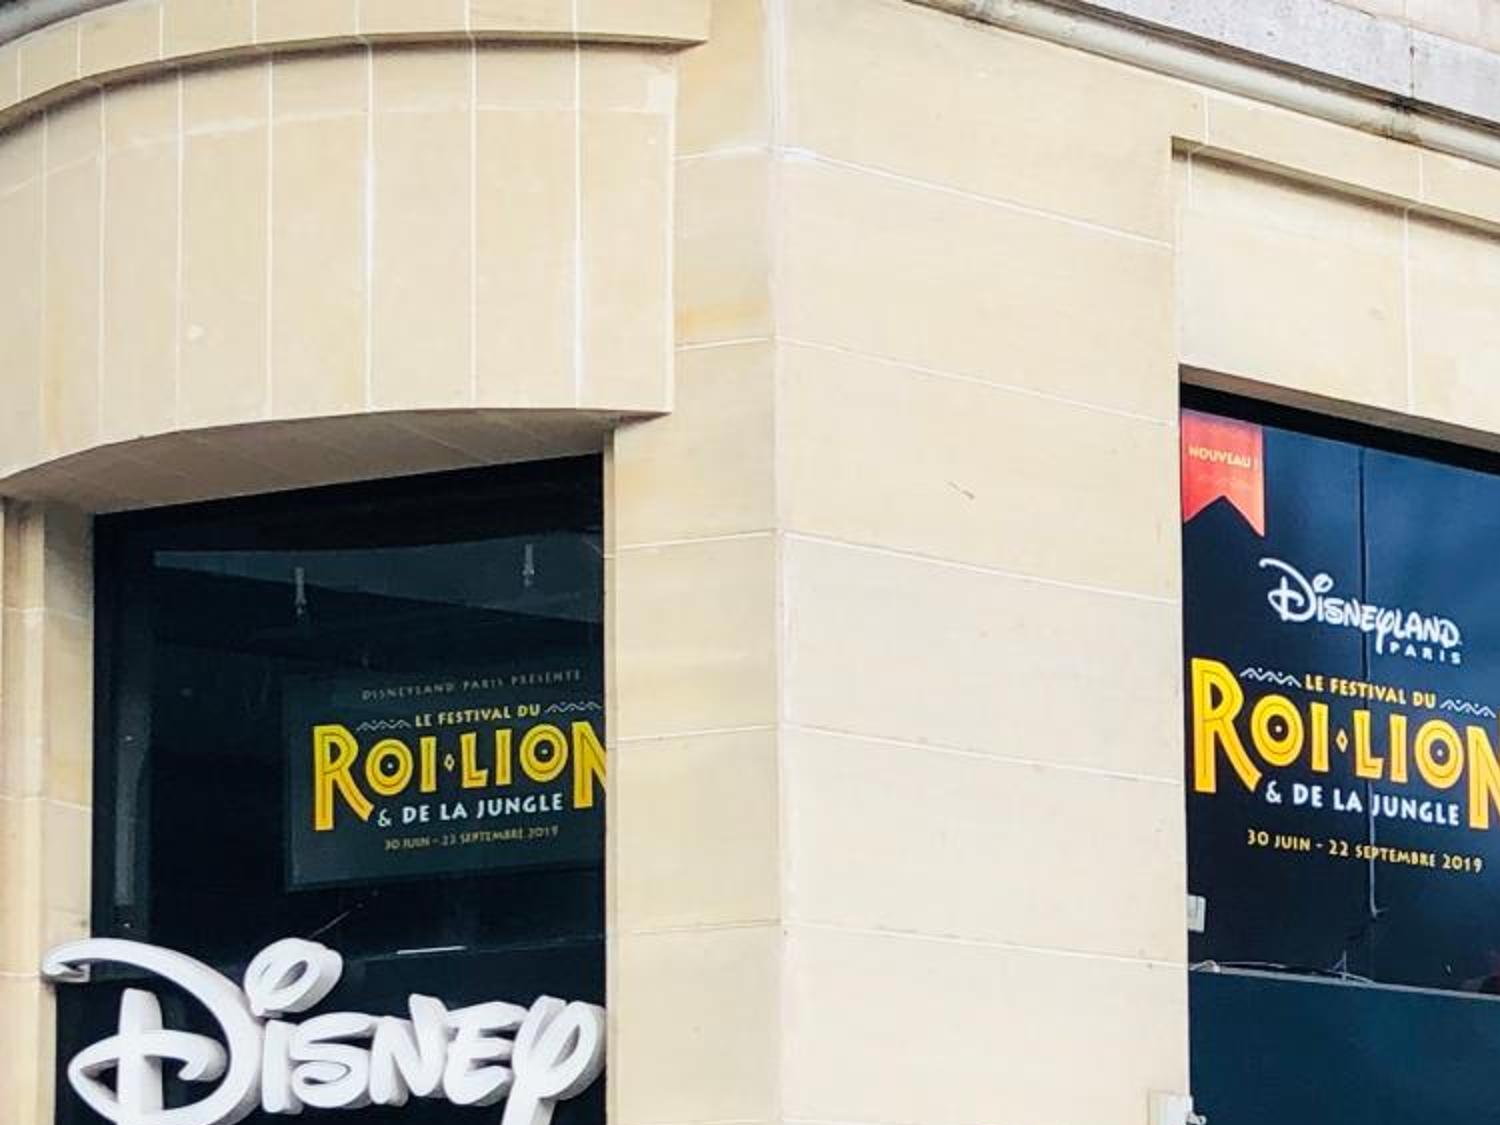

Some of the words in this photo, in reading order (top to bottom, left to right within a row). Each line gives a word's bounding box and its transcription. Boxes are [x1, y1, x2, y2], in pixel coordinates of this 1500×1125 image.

[1188, 445, 1251, 469] NOUVEAU
[1389, 641, 1462, 666] PARIS
[1304, 674, 1325, 692] LE
[1329, 677, 1407, 705] FESTIVAL
[1412, 692, 1437, 709] DU
[415, 714, 433, 728] LE
[438, 707, 511, 726] FESTIVAL
[517, 704, 541, 718] DU
[377, 808, 392, 828] &
[402, 805, 430, 824] DE
[440, 803, 468, 821] LA
[476, 793, 564, 820] JUNGLE
[1264, 780, 1282, 804] &
[1293, 784, 1323, 807] DE
[1333, 789, 1363, 813] LA
[1370, 795, 1461, 826] JUNGLE
[1247, 829, 1269, 846] 30
[1273, 833, 1311, 851] JUIN
[1329, 839, 1350, 857] 22
[1355, 844, 1436, 868] SEPTEMBRE
[1443, 853, 1483, 873] 2019
